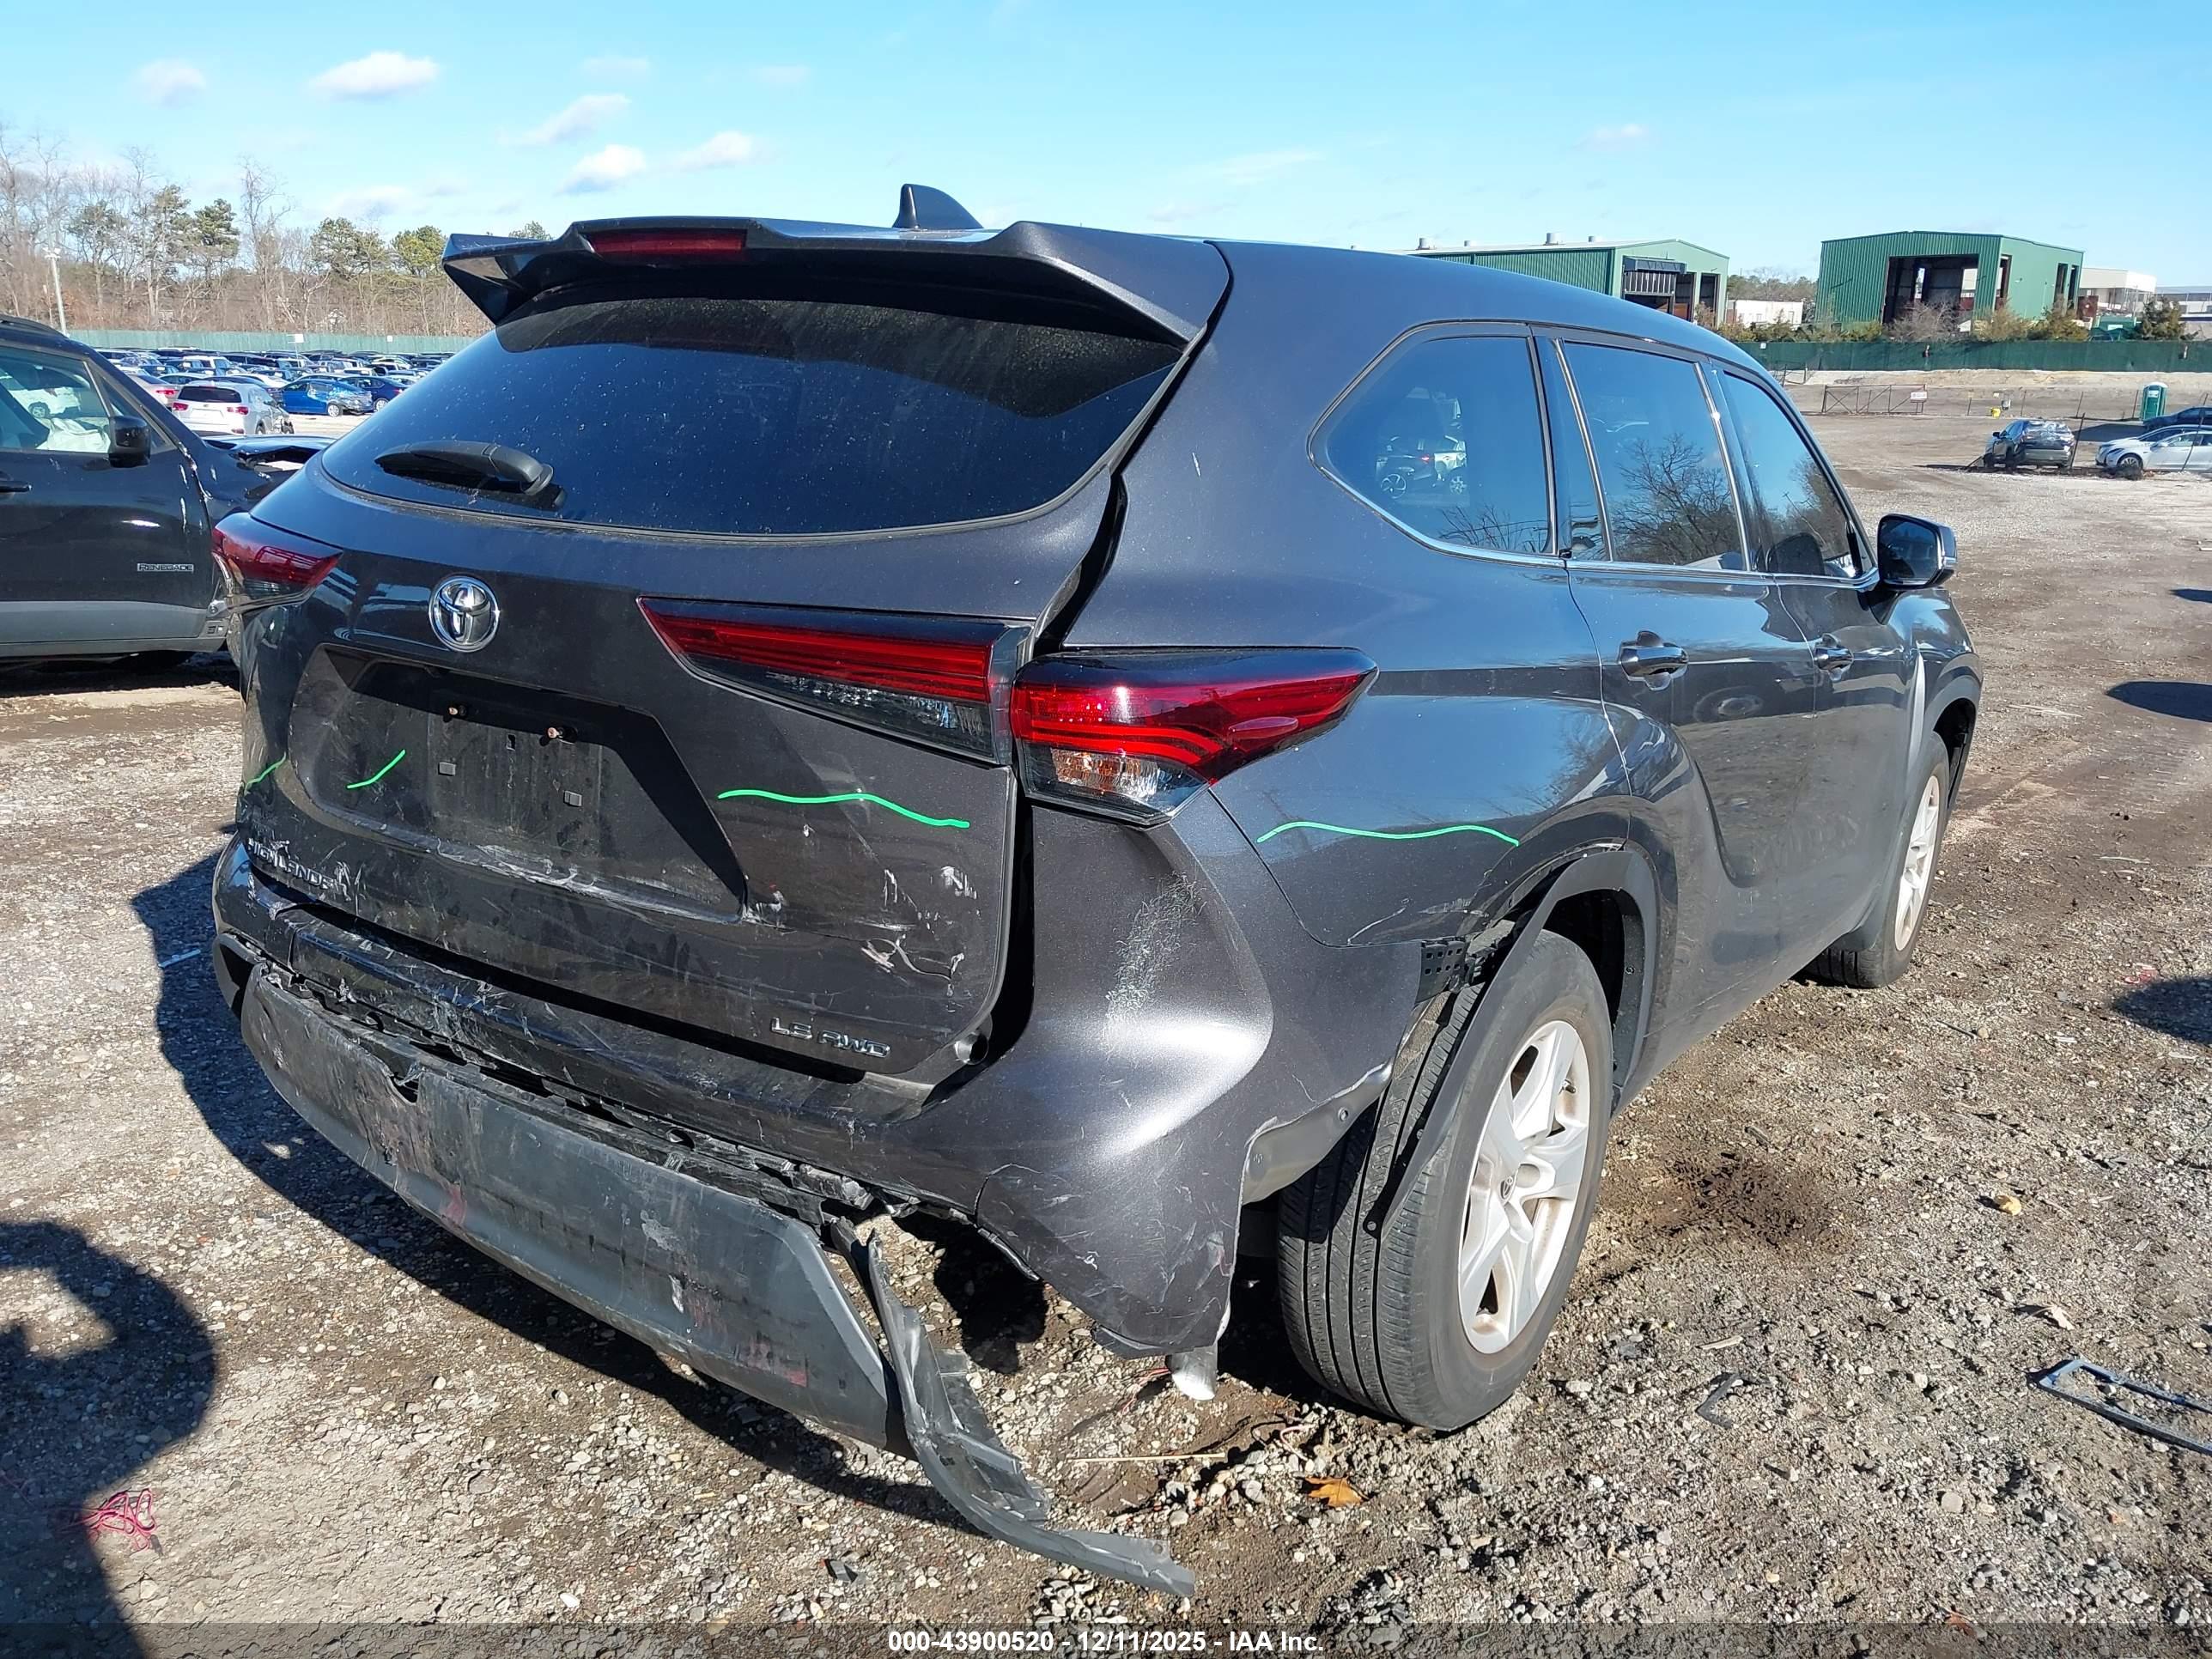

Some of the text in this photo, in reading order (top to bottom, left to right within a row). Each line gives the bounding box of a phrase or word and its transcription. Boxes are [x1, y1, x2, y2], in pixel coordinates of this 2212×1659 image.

[137, 562, 194, 573] RENEGADE
[247, 837, 341, 891] HIGHLANDE
[772, 1017, 891, 1058] LE AWD
